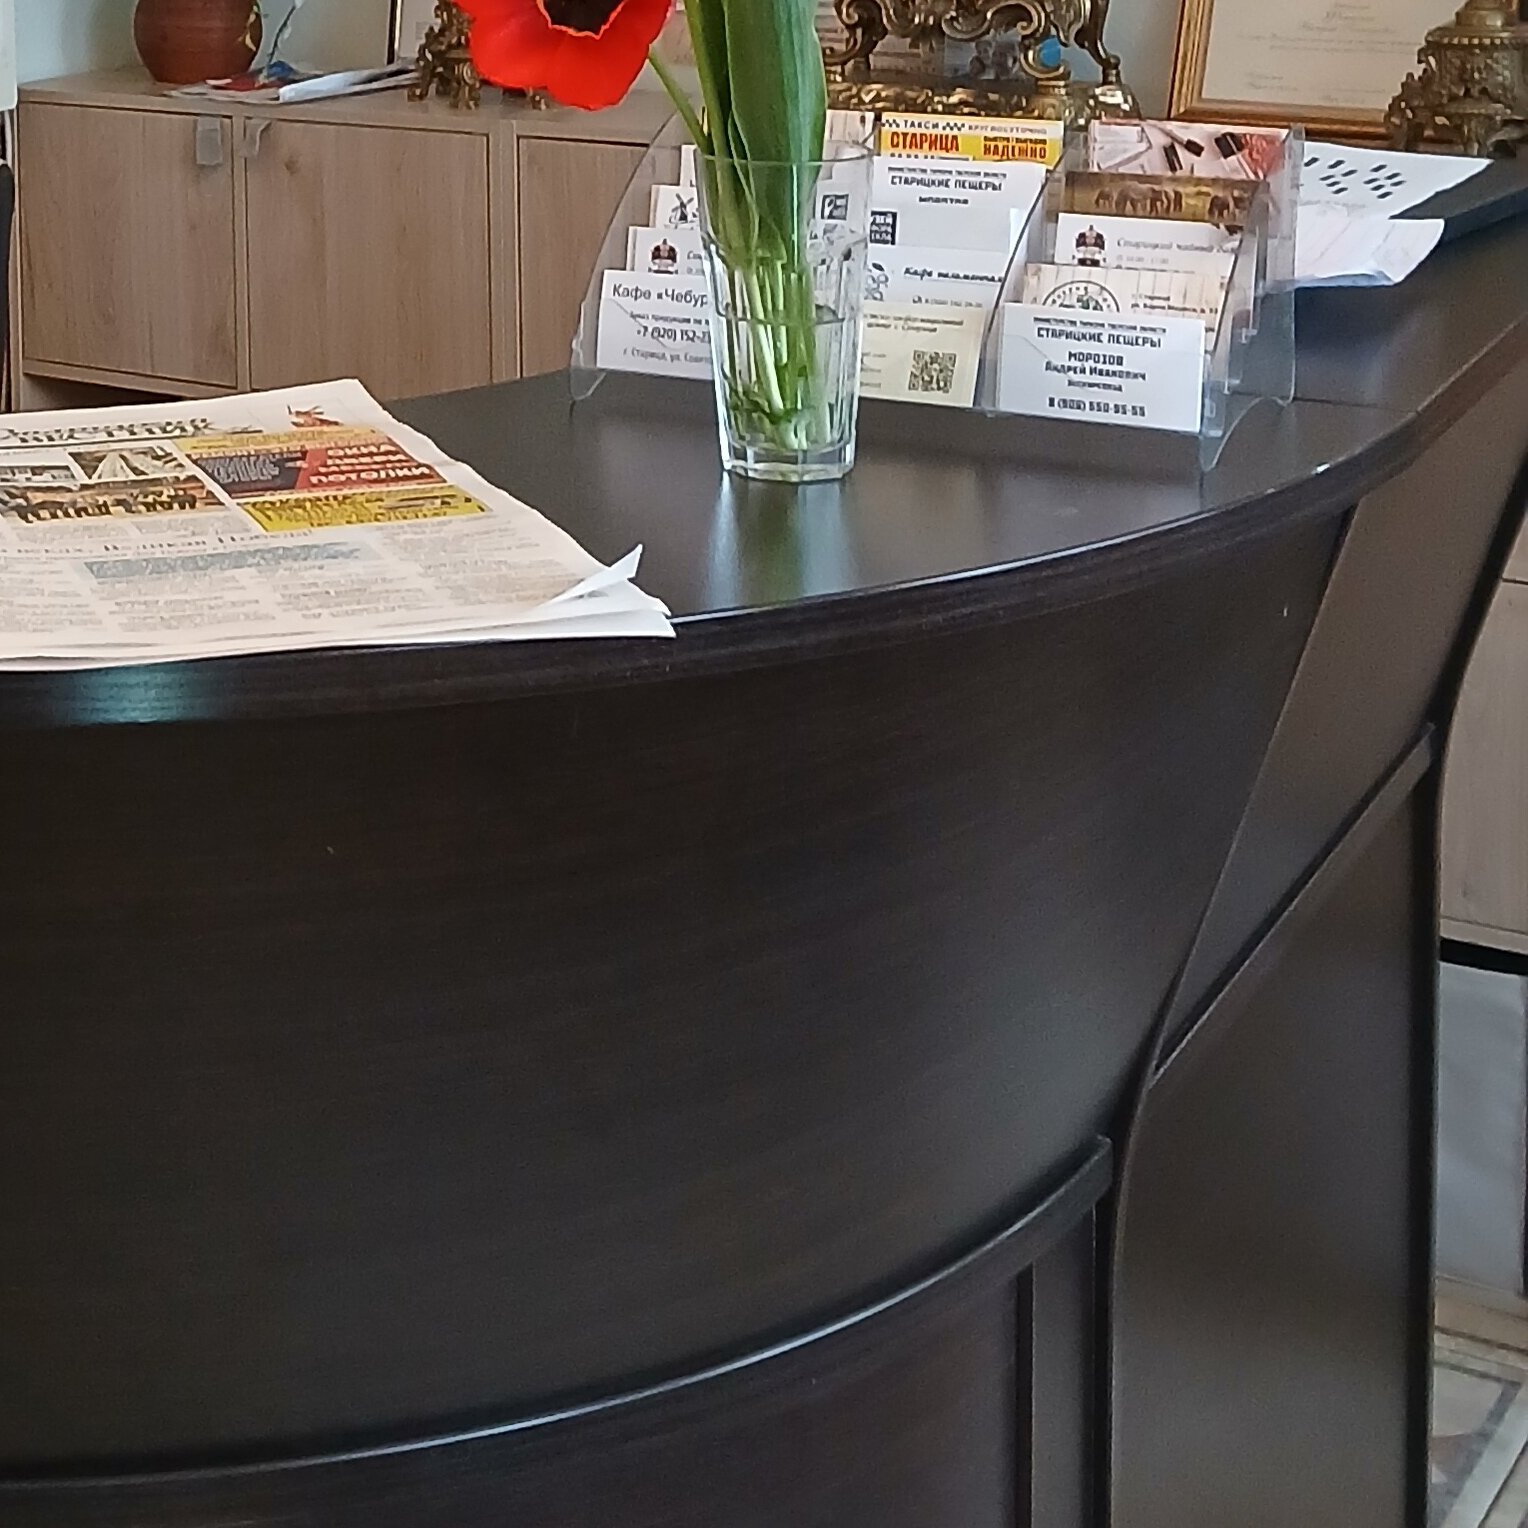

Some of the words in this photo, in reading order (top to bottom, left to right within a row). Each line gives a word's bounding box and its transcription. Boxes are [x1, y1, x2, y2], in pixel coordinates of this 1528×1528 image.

[904, 120, 939, 129] ТАКСИ
[890, 132, 960, 153] СТАРИЦА
[891, 175, 951, 188] СТАРИЦКИЕ
[955, 179, 1002, 191] ПЕЩЕРЫ
[612, 283, 651, 301] Кафе
[657, 288, 708, 308] «Чебур
[1037, 327, 1103, 344] СТАРИЦКИЕ
[1107, 333, 1161, 348] ПЕЩЕРЫ
[1068, 351, 1124, 366] МОРОЗОВ
[327, 444, 397, 456] ОКНА
[309, 467, 430, 484] ПОТОЛКИ
